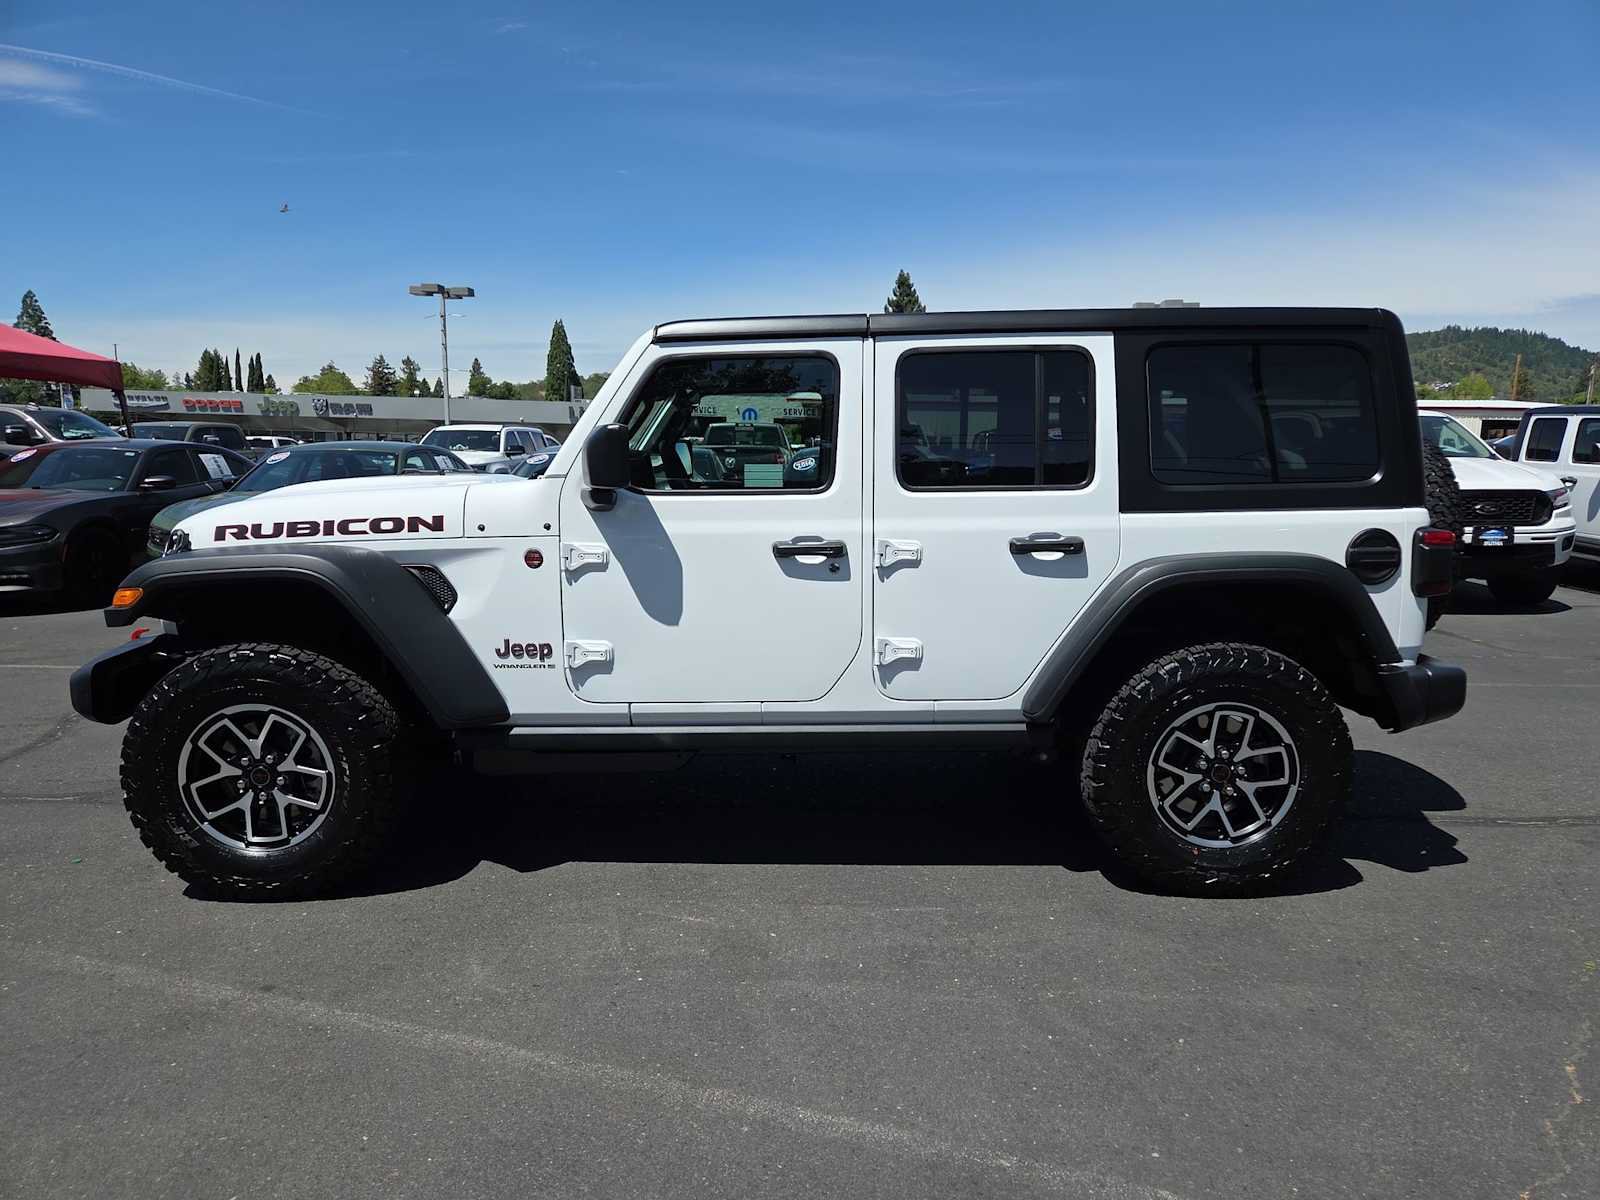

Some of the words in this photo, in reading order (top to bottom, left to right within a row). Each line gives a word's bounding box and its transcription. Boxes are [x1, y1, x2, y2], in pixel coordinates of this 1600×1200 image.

[257, 396, 299, 415] Jeep
[783, 407, 817, 416] SERVICE
[213, 515, 445, 542] RUBICON
[495, 639, 553, 662] Jeep
